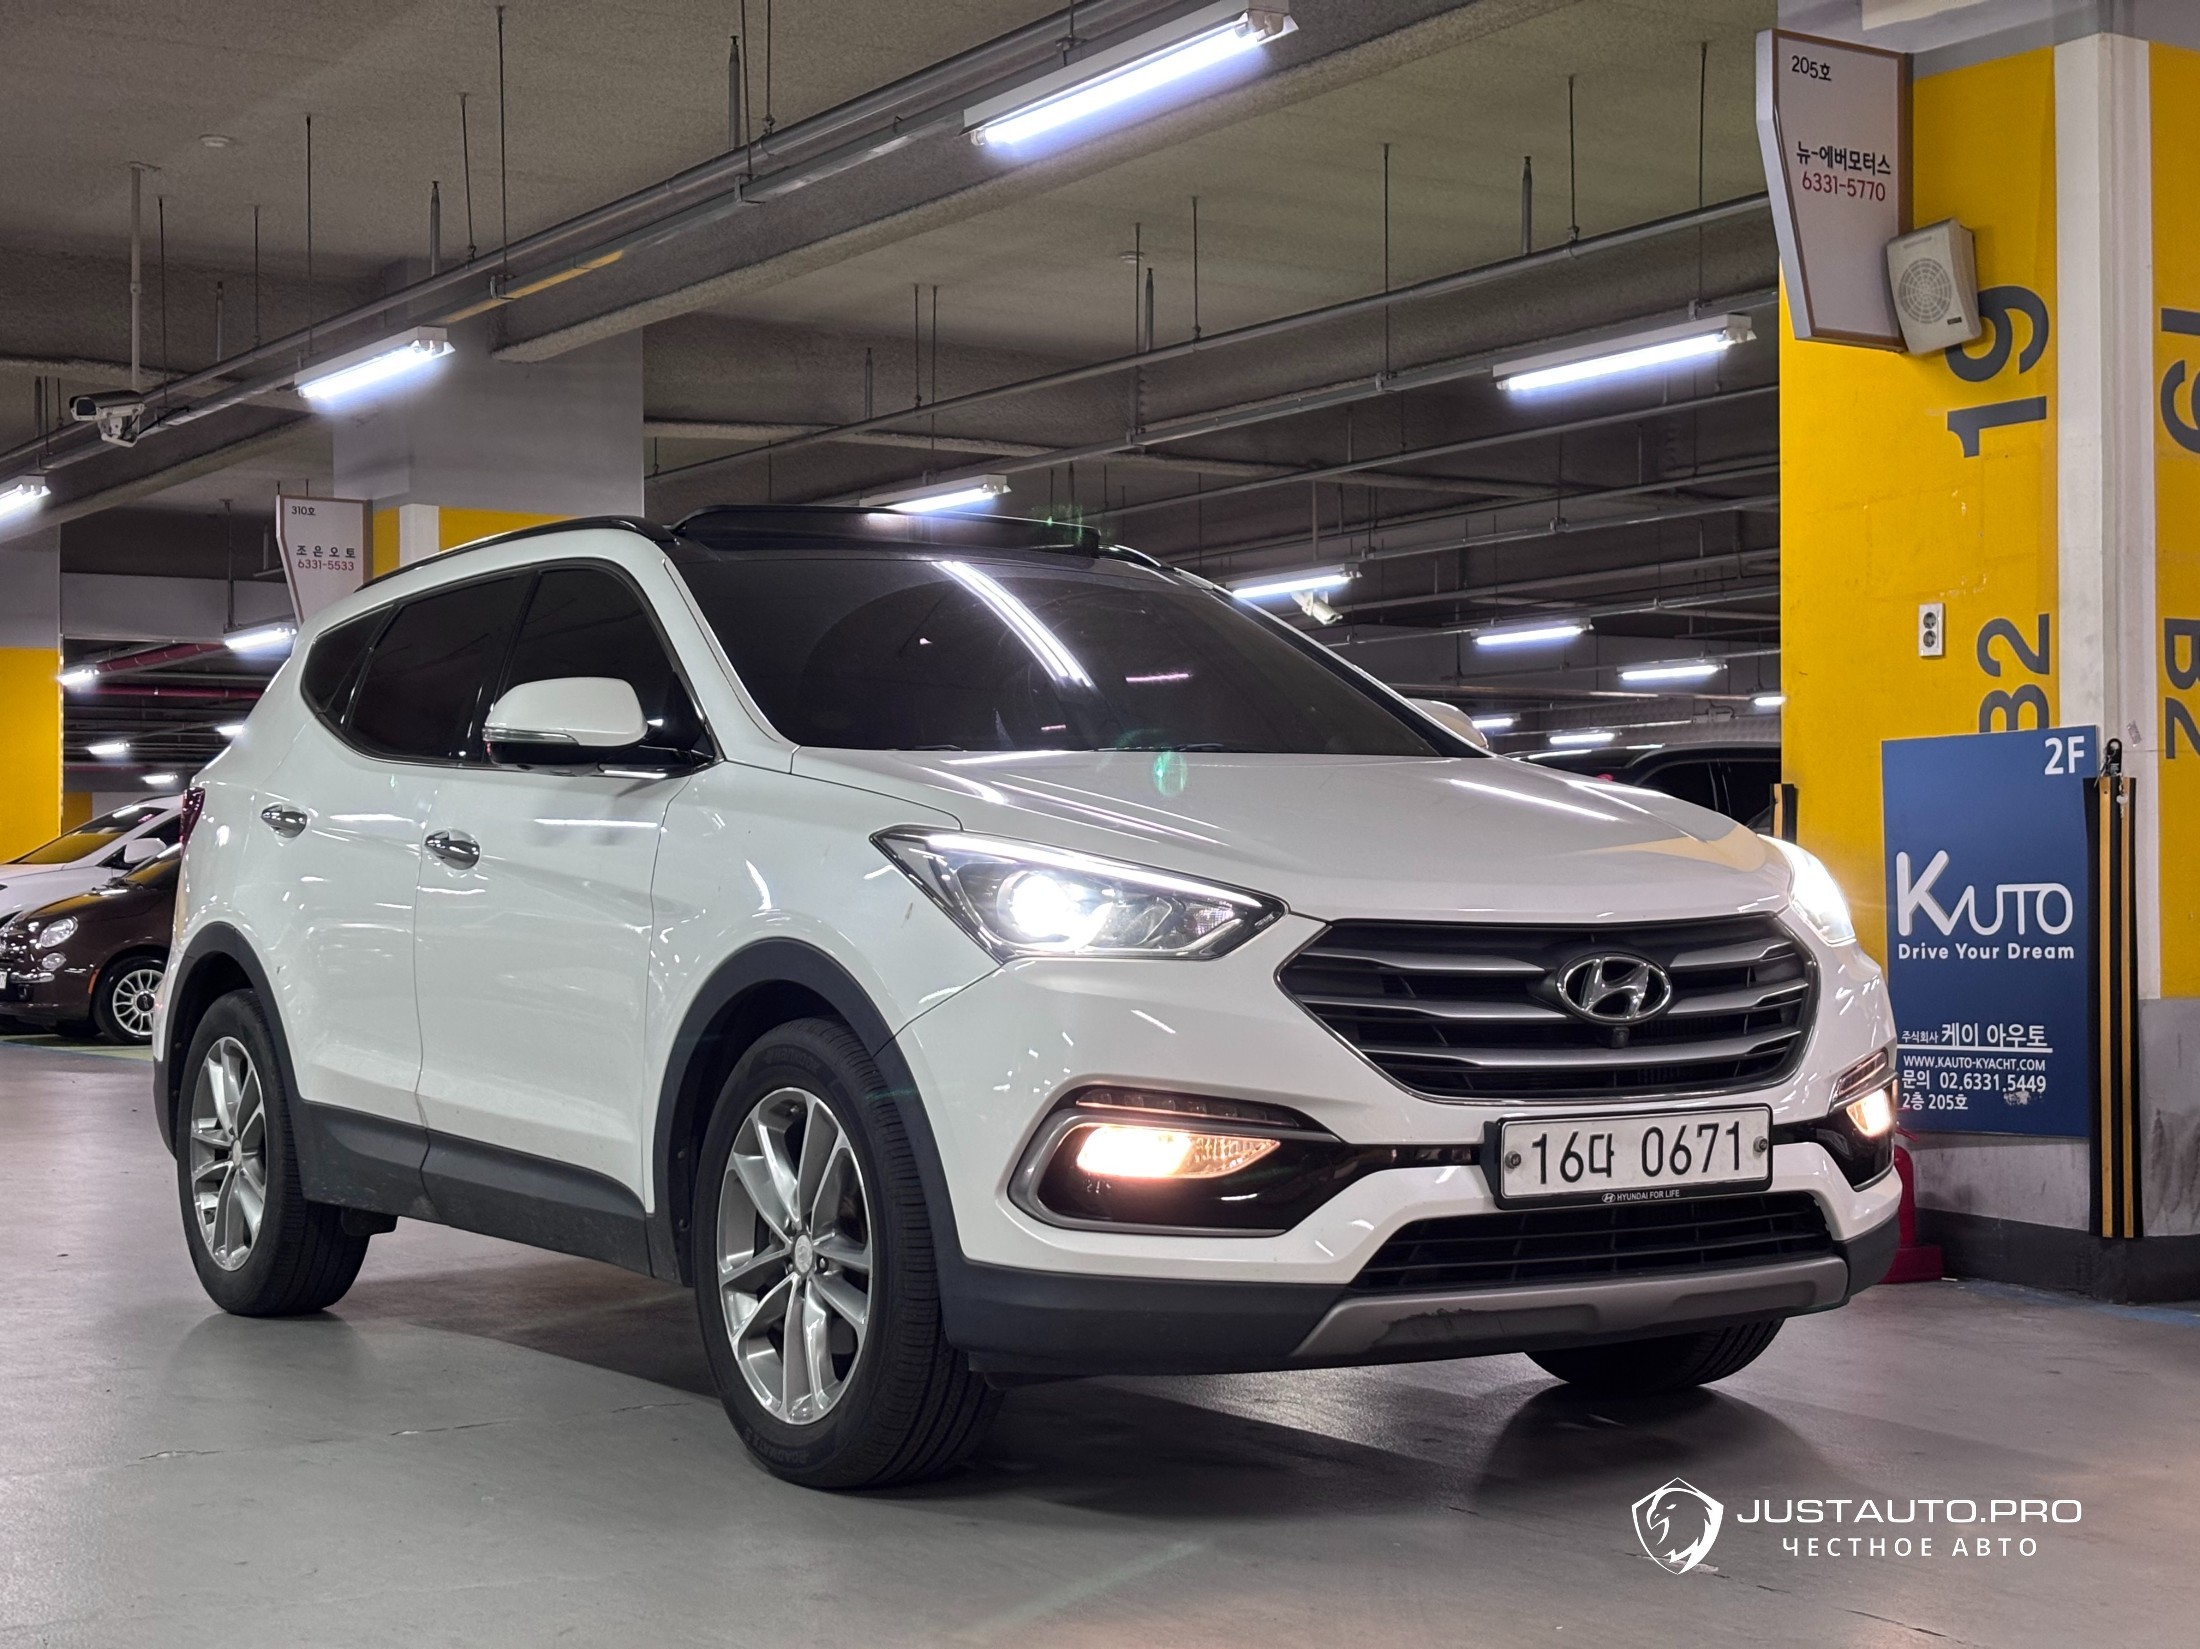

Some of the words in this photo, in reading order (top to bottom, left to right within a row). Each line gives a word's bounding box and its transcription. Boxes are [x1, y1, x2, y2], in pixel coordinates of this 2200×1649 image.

[1792, 55, 1832, 81] 205호
[1796, 141, 1891, 176] 뉴-에버모터스
[1802, 171, 1886, 201] 6331-5770
[291, 506, 316, 516] 310호
[298, 559, 354, 571] 6331-5533
[2044, 736, 2085, 775] 2F
[1898, 942, 1949, 959] Drive
[1955, 943, 2000, 959] Your
[2007, 943, 2075, 959] Dream
[1901, 1030, 1938, 1043] 주식회사
[1941, 1022, 1979, 1047] 케이
[1987, 1023, 2048, 1048] 아우토
[1903, 1056, 2046, 1071] WWW.KAUTO-KYACHT.COM
[1902, 1070, 1930, 1090] 문의
[1940, 1072, 2047, 1093] 02.6331.5449
[1902, 1091, 1925, 1111] 2층
[1928, 1093, 1969, 1110] 205호
[1531, 1130, 1615, 1184] 16다
[1640, 1120, 1740, 1177] 0671
[1617, 1192, 1648, 1201] HYUNDAI
[1649, 1190, 1664, 1199] FOR
[1665, 1189, 1680, 1198] LIFE
